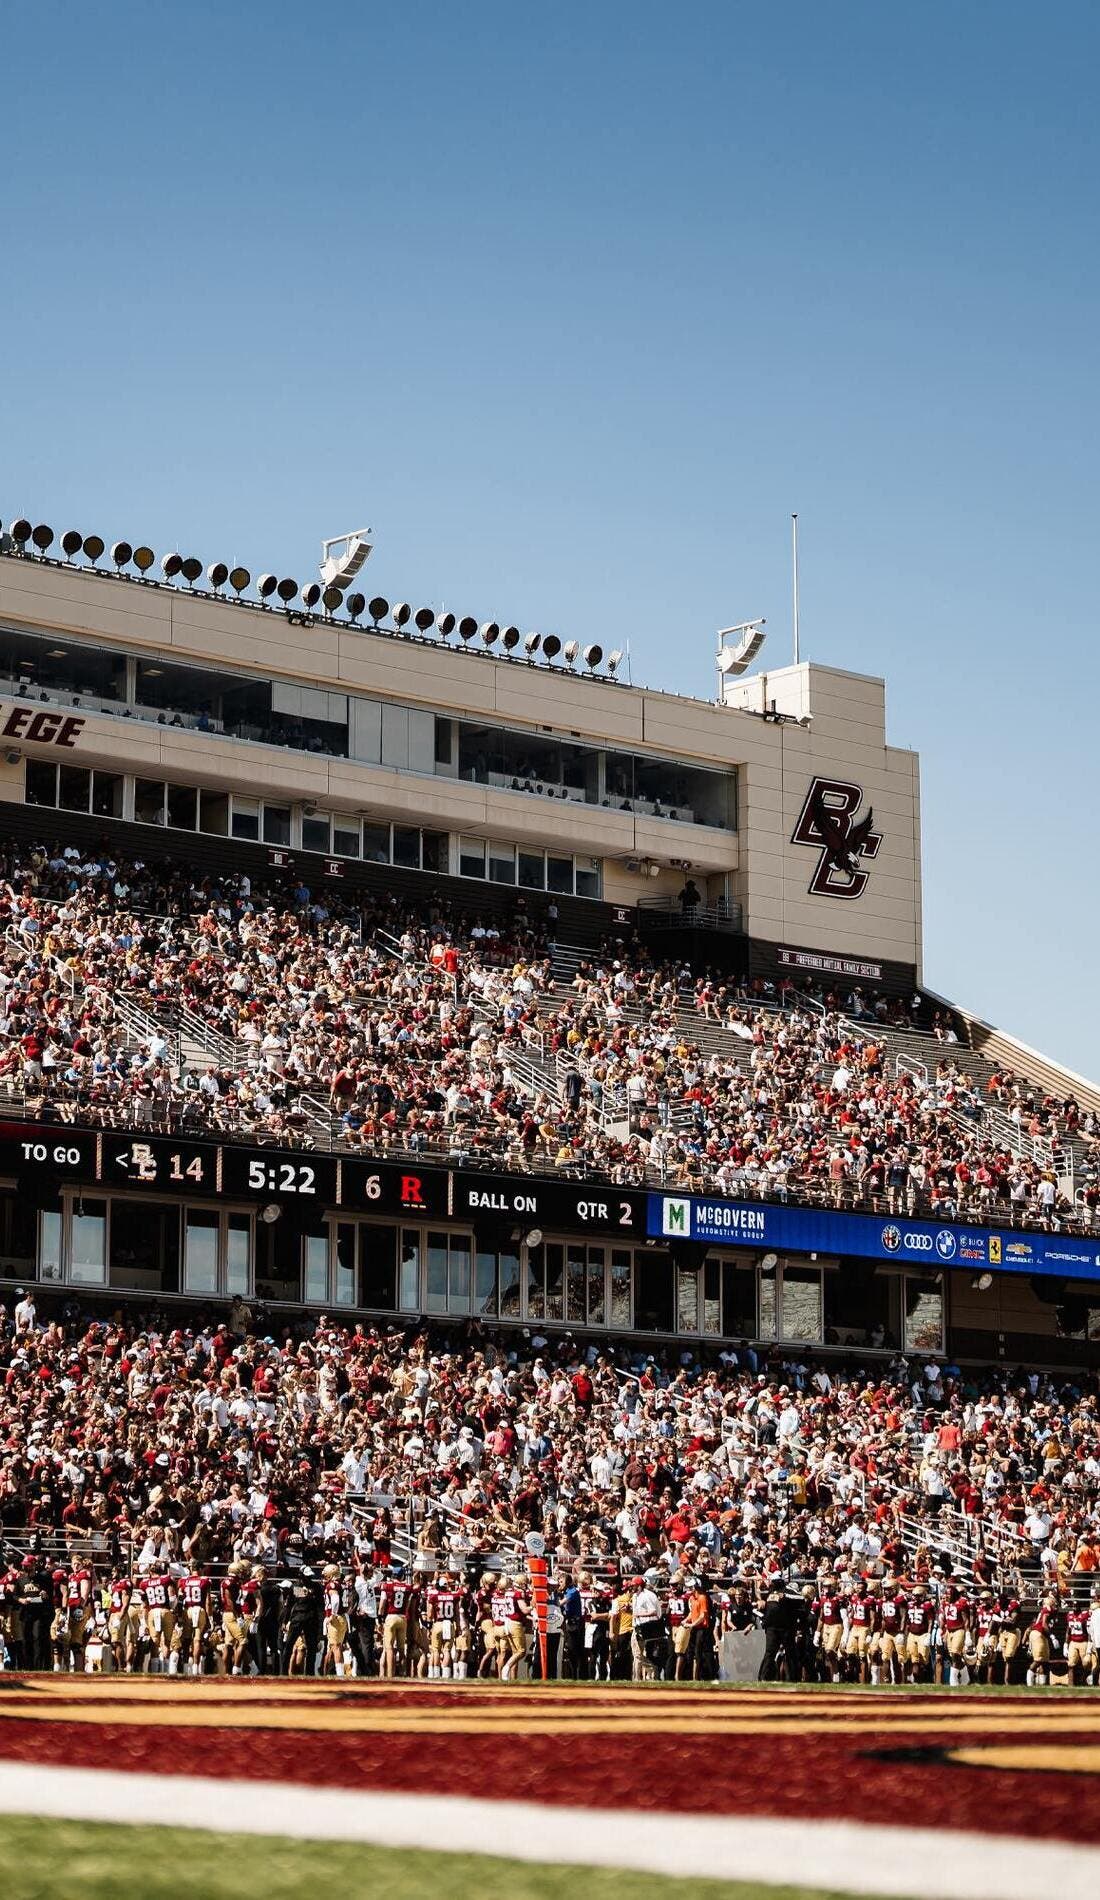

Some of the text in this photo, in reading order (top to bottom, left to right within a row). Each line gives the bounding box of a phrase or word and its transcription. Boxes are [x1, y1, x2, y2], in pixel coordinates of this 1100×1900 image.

[0, 705, 86, 747] EGE
[22, 1143, 81, 1165] TO GO
[169, 1154, 204, 1182] 14
[248, 1161, 316, 1194] 5:22
[365, 1175, 423, 1202] 6 R
[468, 1190, 537, 1213] BALL ON
[577, 1201, 633, 1225] QTR 2
[669, 1203, 684, 1230] M
[696, 1227, 765, 1239] AUTOMOTIVE GROUP
[1045, 1252, 1090, 1263] PORSCHE
[394, 1591, 404, 1609] 8
[437, 1602, 454, 1619] 10
